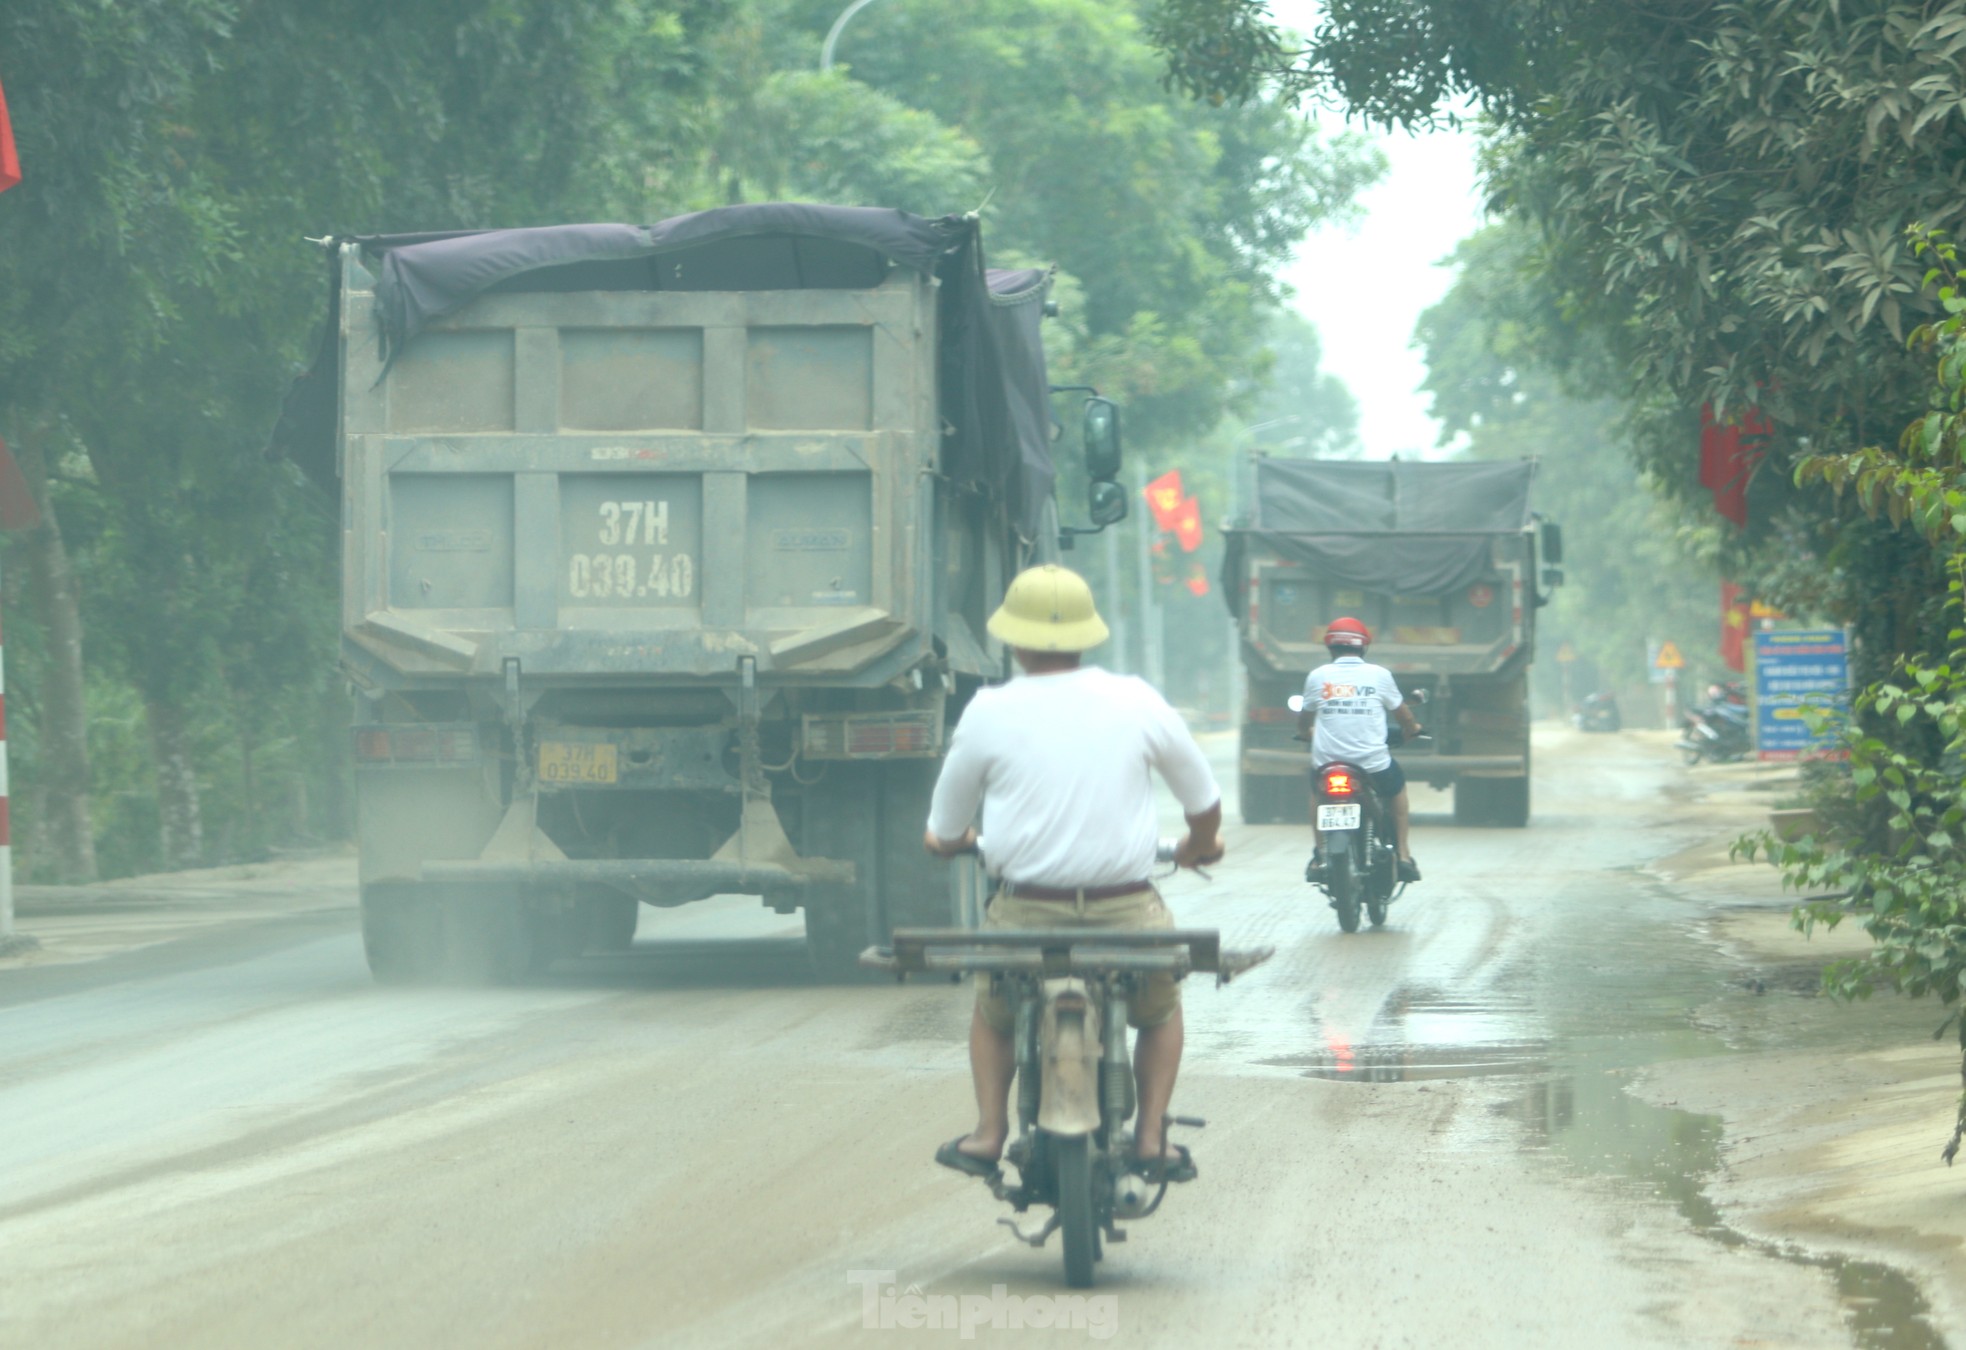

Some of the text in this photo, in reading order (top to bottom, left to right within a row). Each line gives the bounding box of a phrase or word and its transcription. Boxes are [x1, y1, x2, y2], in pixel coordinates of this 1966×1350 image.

[598, 501, 668, 545] 37H
[569, 554, 692, 597] 039.40
[561, 744, 595, 761] 37H
[547, 763, 607, 780] 039.40
